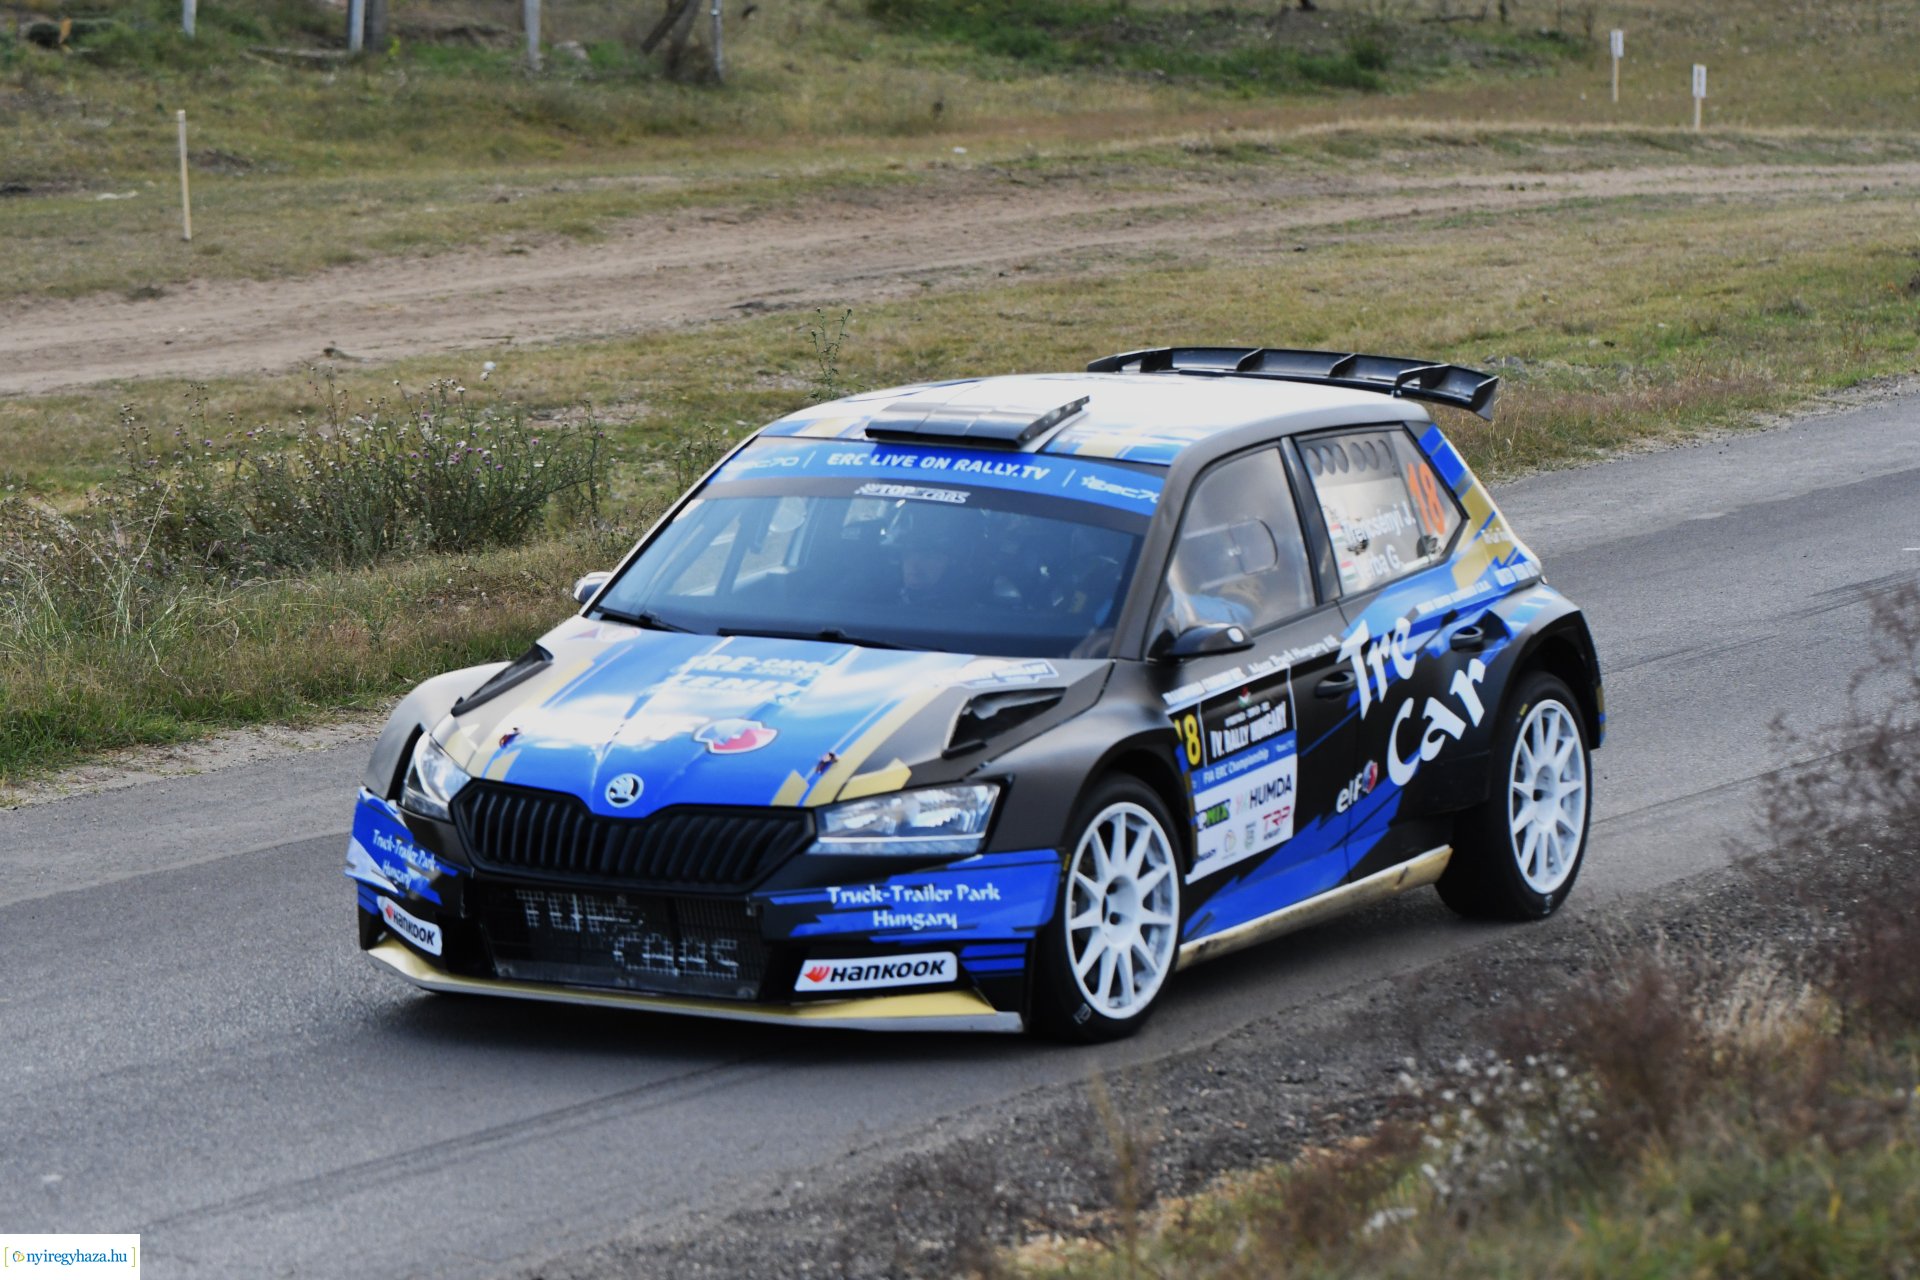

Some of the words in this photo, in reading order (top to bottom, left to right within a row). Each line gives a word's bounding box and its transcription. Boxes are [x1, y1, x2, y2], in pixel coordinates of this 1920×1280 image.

[827, 453, 867, 466] ERC
[870, 454, 917, 468] LIVE
[919, 456, 950, 470] ON
[953, 458, 1050, 481] RALLY.TV
[1407, 463, 1446, 535] 18
[1336, 617, 1417, 721] Tre
[1223, 725, 1250, 754] RALLY
[1249, 700, 1287, 743] HUNGARY
[1387, 658, 1486, 786] Car
[1249, 774, 1293, 810] HUMDA
[826, 882, 953, 905] Truck-Trailer
[956, 882, 1002, 902] Park
[872, 909, 958, 931] Hungary
